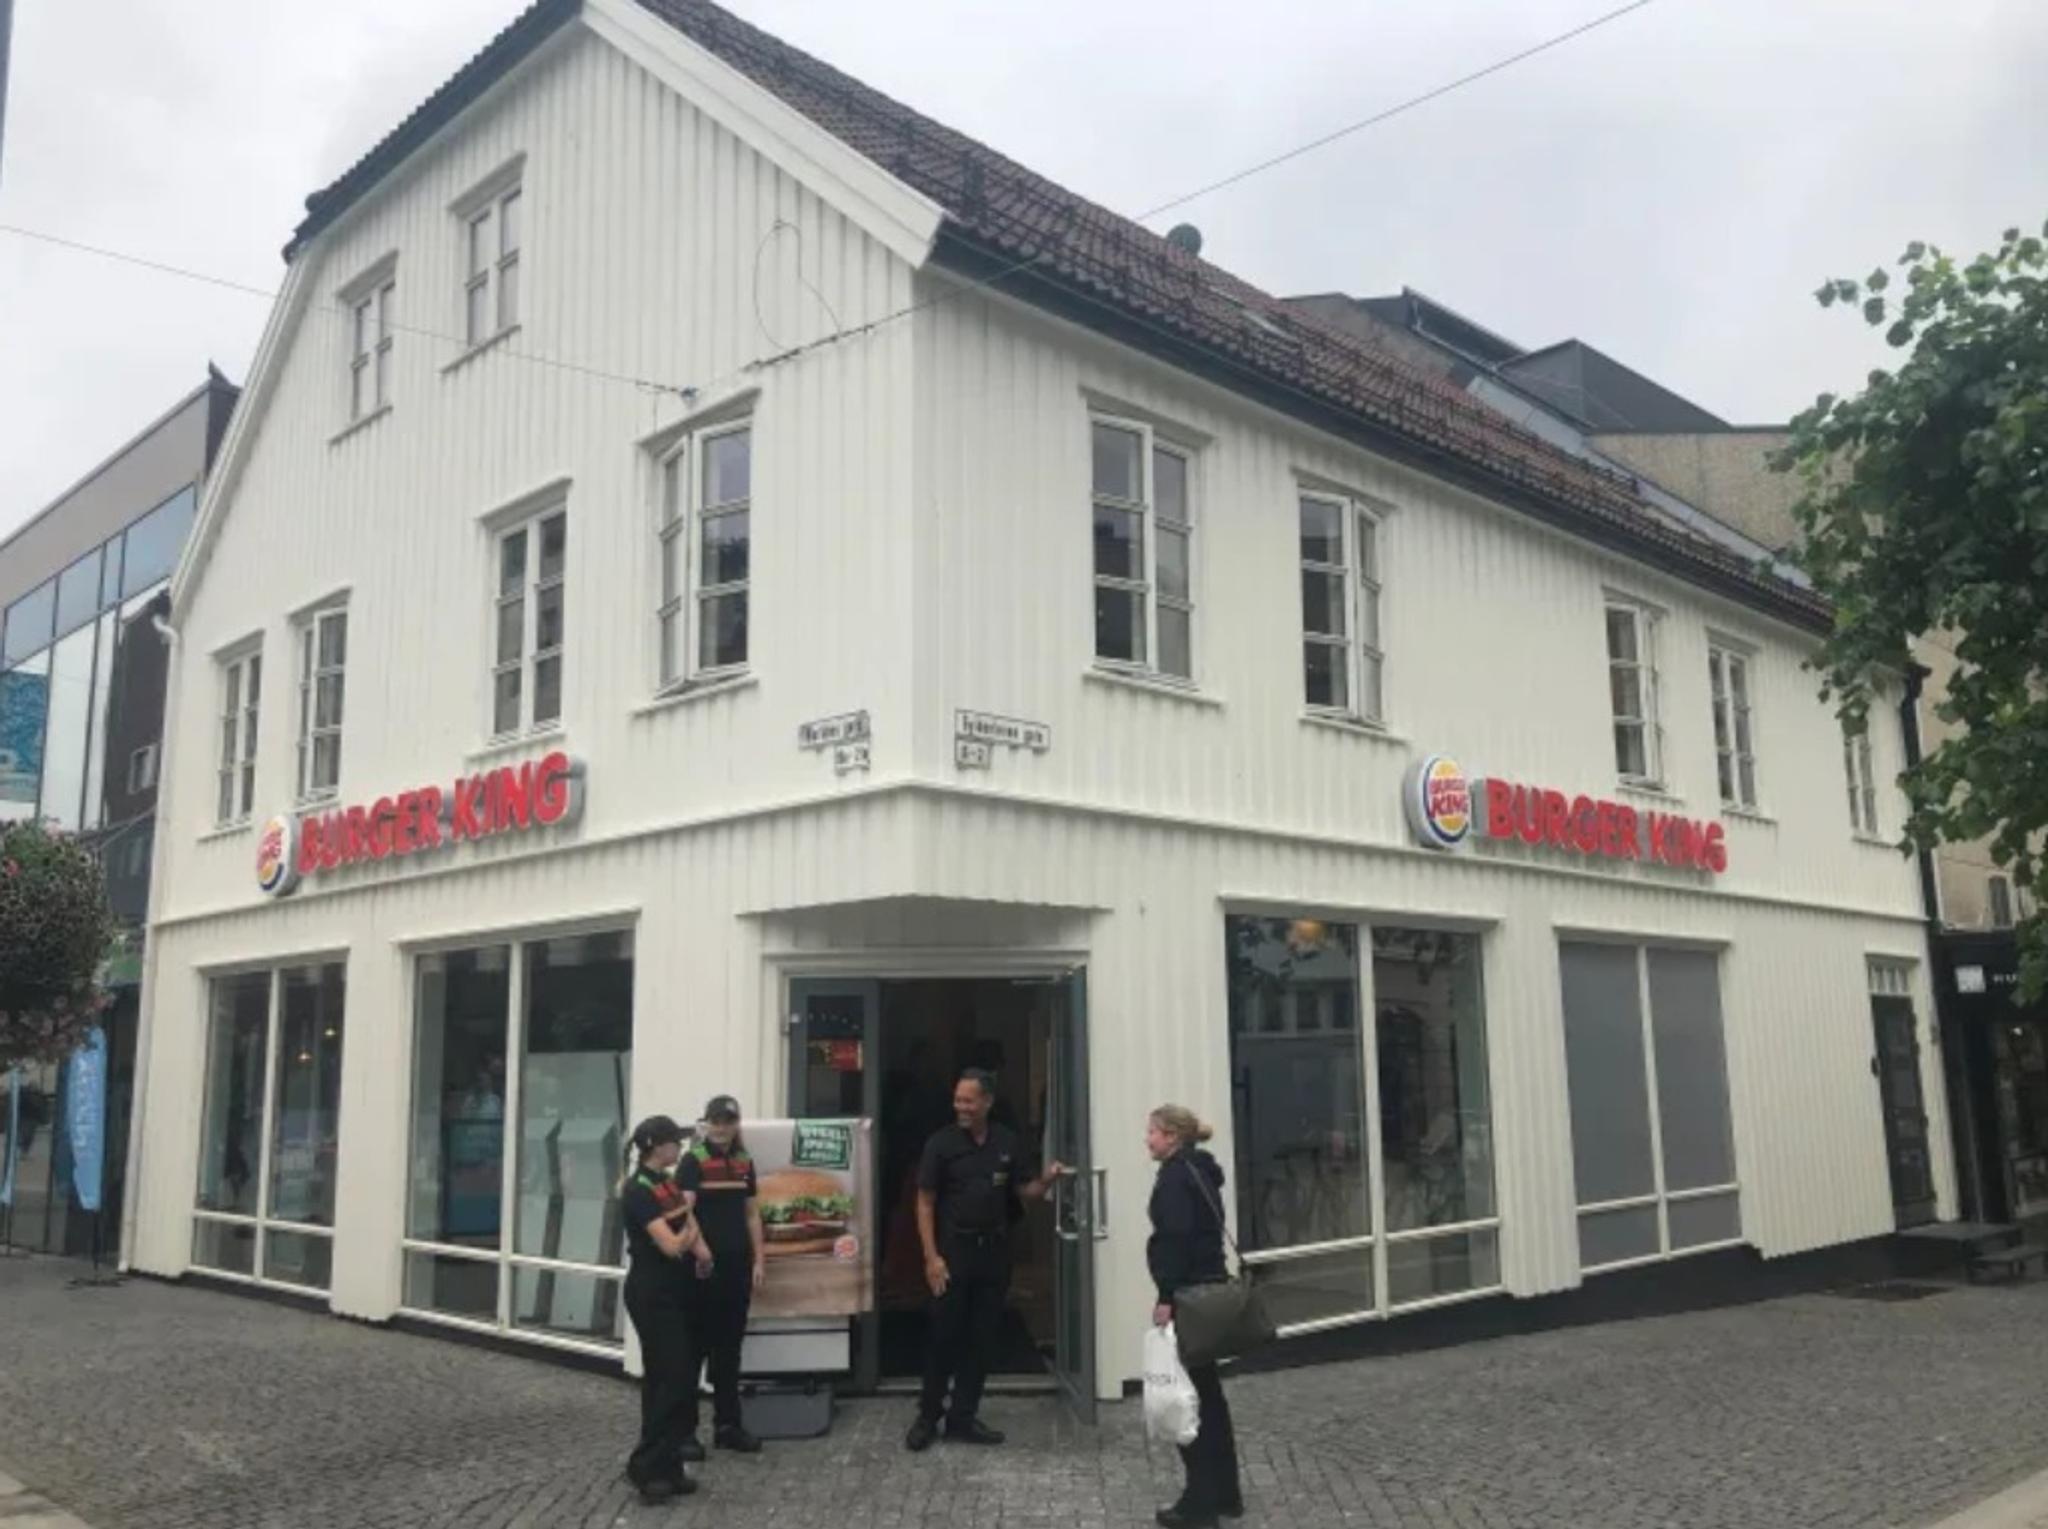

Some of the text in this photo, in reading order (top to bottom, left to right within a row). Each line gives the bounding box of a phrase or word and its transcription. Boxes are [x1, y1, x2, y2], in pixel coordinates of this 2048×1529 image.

[297, 751, 570, 874] BURGER KING
[1485, 777, 1727, 874] BURGER KING
